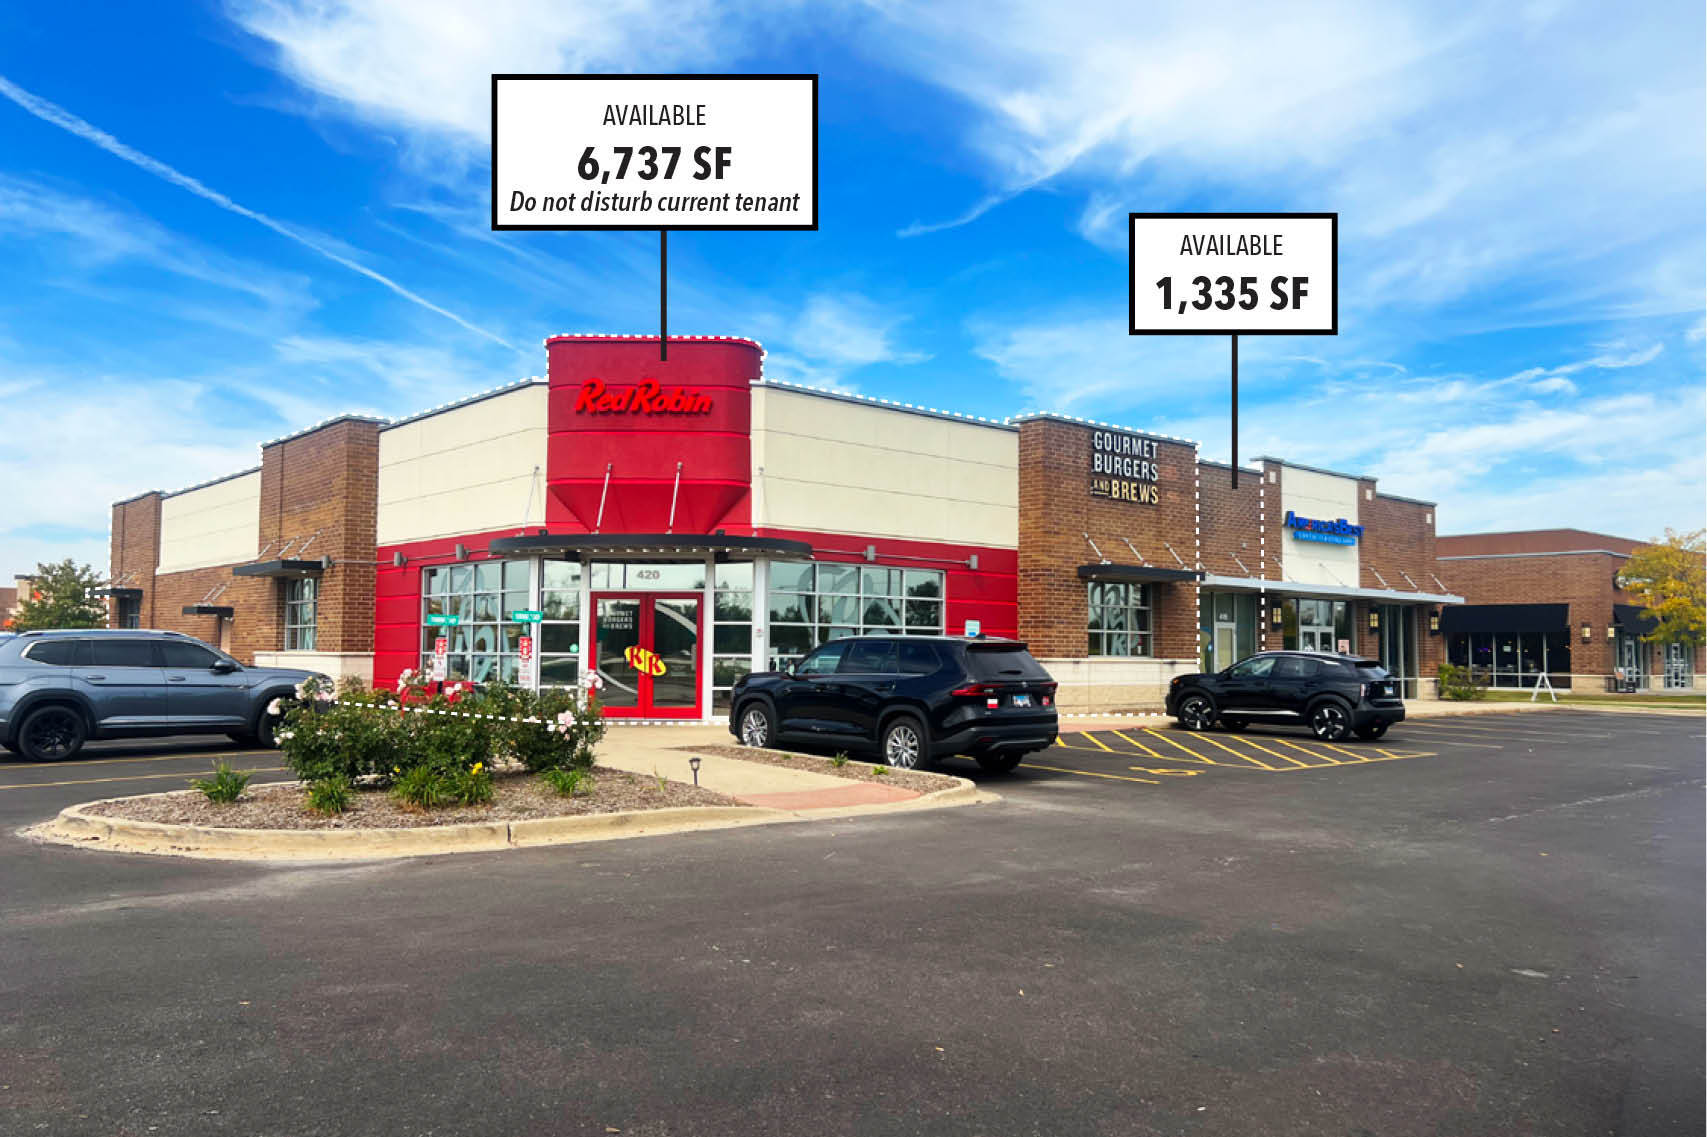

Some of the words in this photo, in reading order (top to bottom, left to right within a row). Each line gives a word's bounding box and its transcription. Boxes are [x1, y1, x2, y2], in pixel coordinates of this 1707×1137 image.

[575, 377, 633, 413] Red
[631, 377, 713, 414] Robin
[1094, 431, 1159, 459] GOURMET
[1093, 453, 1159, 482] BURGERS
[1093, 479, 1111, 493] AND
[1111, 479, 1159, 504] BREWS
[637, 570, 660, 580] 420
